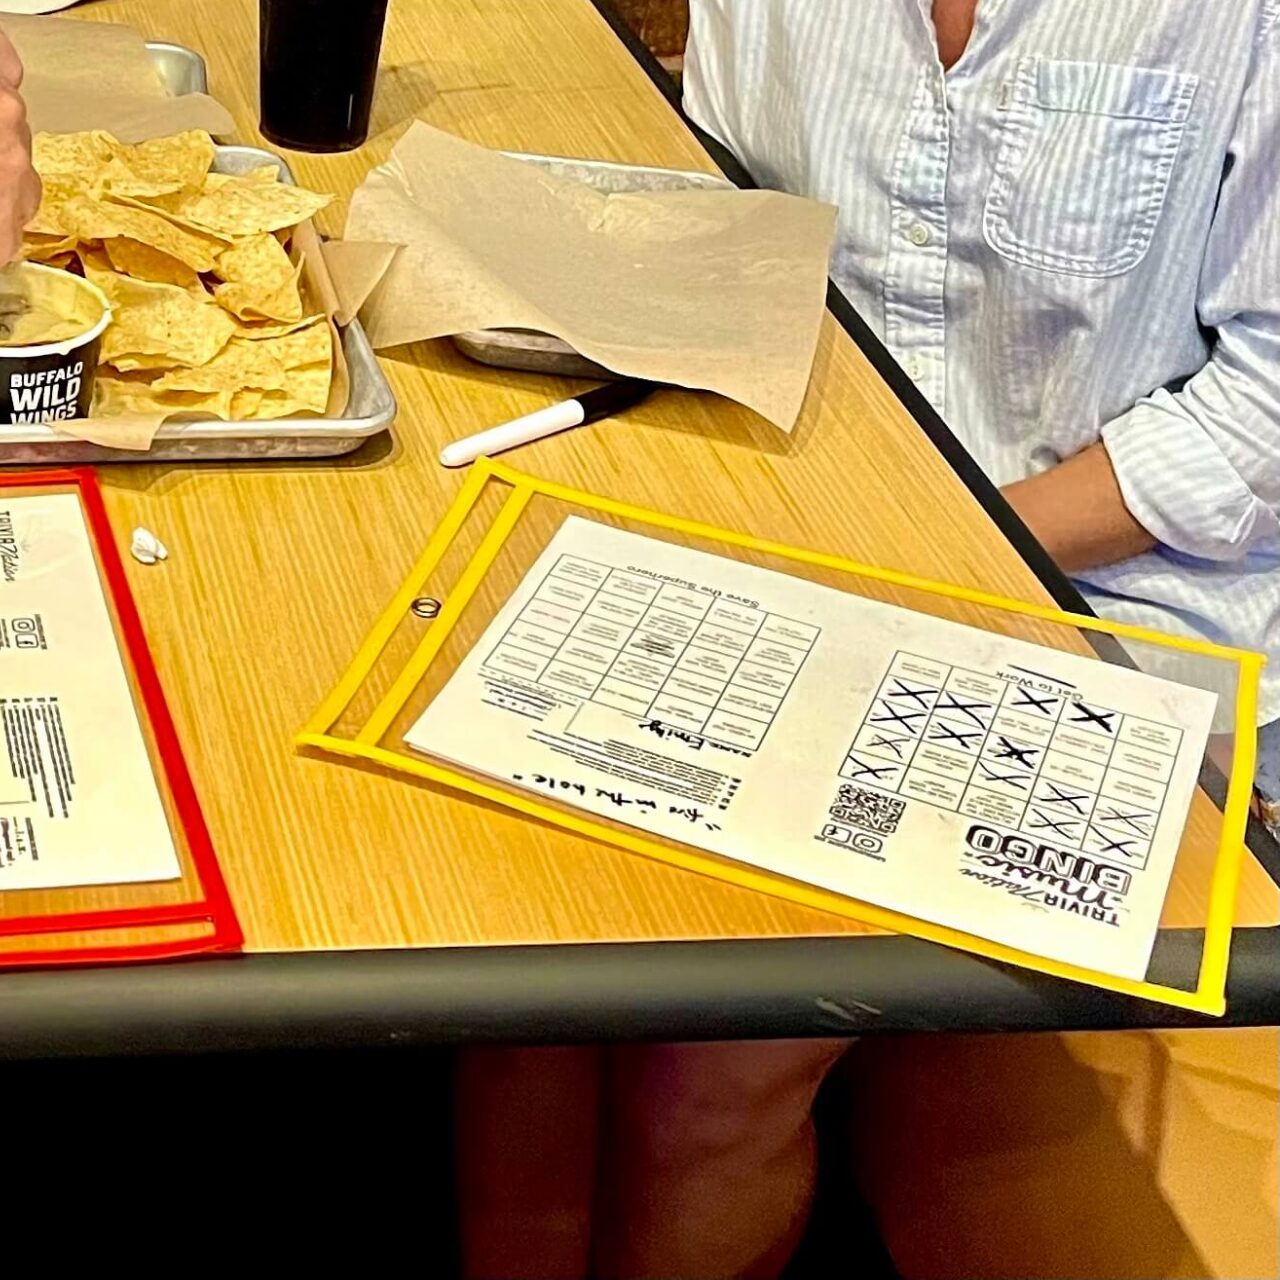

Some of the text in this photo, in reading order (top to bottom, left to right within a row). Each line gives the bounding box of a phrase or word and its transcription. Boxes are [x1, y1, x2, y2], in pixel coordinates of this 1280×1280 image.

[10, 361, 84, 388] BUFFALO
[9, 377, 81, 412] WILD
[10, 400, 78, 425] WINGS
[626, 565, 761, 610] Save the Superhero
[995, 670, 1035, 690] Work
[1038, 683, 1053, 694] to
[965, 824, 1132, 896] BINGO
[976, 853, 1114, 912] Music
[1042, 892, 1120, 927] TRIVIA
